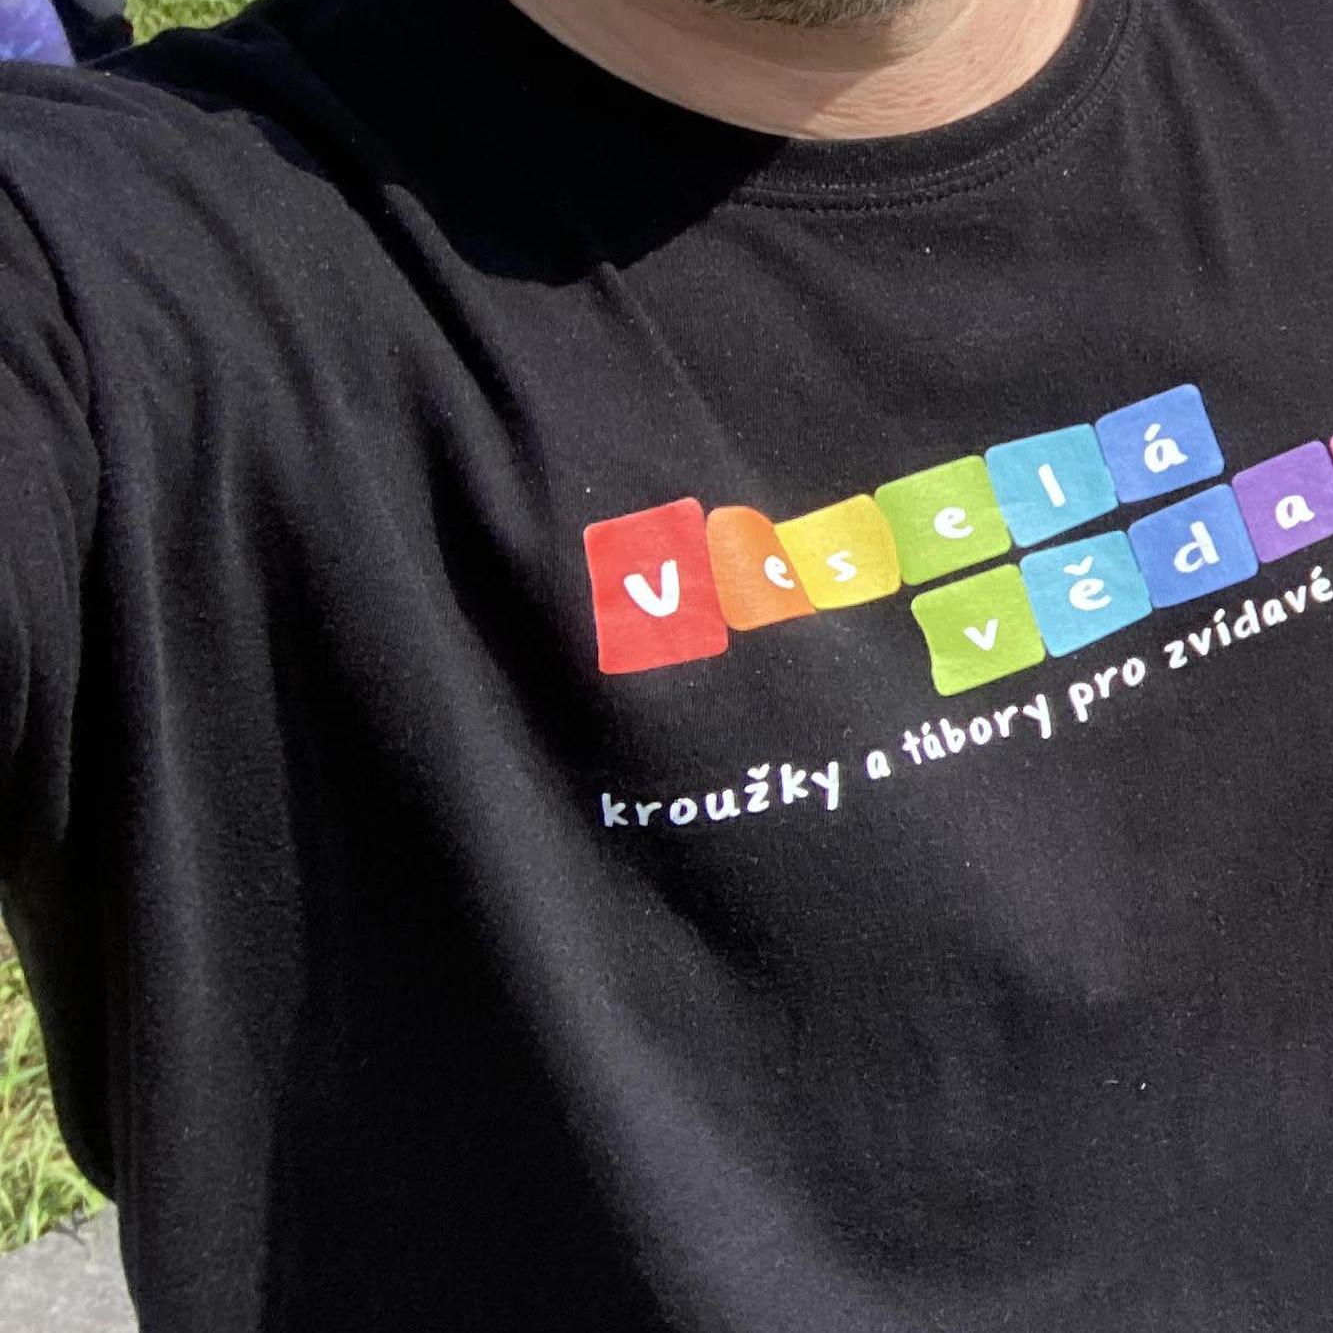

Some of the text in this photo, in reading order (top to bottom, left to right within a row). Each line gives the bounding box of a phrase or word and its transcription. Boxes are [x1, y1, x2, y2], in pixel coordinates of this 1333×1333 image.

[624, 423, 1187, 616] veselá
[602, 761, 840, 827] kroužky
[865, 751, 892, 780] a
[902, 693, 1052, 765] tábory
[1068, 657, 1146, 723] pro
[1163, 565, 1333, 669] zvídavé
